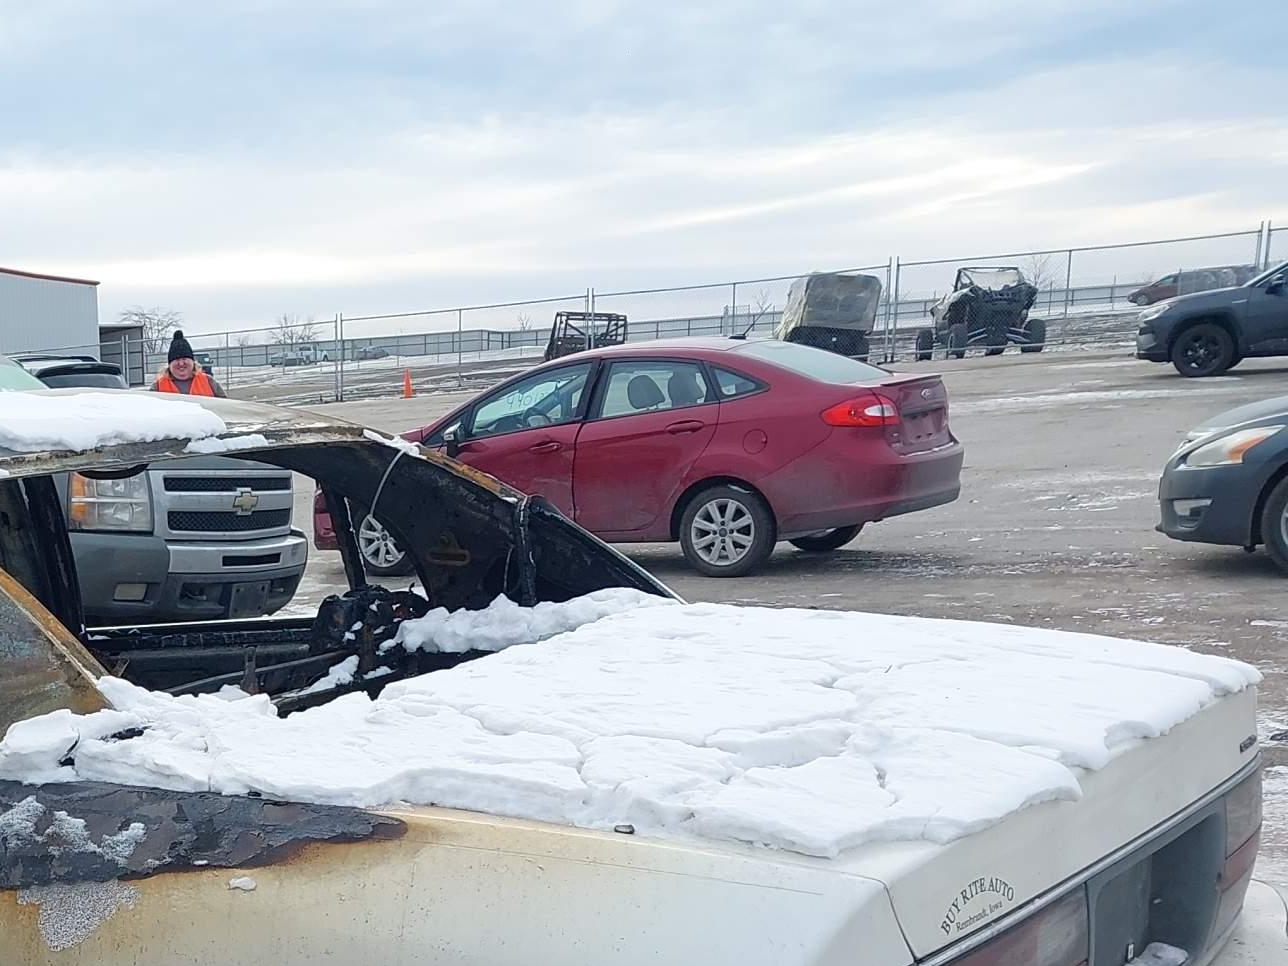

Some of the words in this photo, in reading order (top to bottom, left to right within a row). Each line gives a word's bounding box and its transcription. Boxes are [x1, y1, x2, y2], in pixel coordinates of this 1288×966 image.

[940, 897, 962, 937] BUY
[960, 877, 986, 905] RITE
[988, 877, 1015, 902] AUTO
